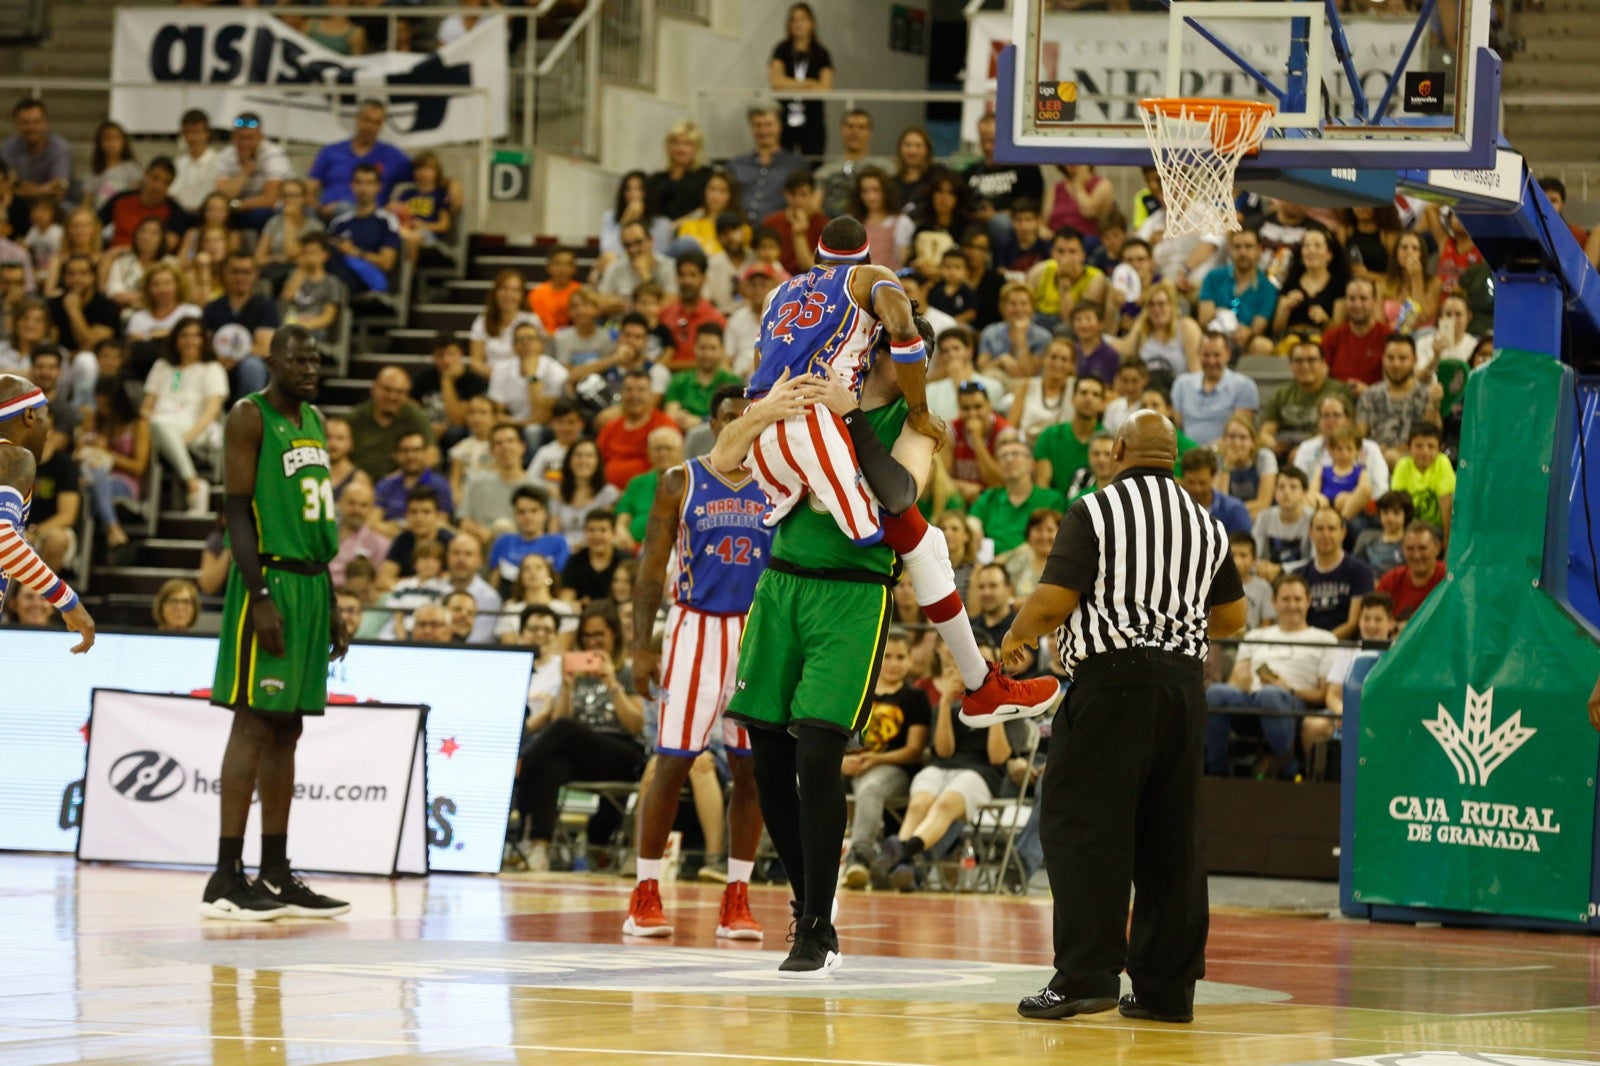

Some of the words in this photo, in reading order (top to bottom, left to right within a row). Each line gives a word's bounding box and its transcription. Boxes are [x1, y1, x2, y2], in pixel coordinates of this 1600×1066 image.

[1039, 100, 1062, 111] LEB
[1039, 111, 1060, 120] ORO
[493, 163, 522, 199] D
[771, 291, 828, 340] 26
[301, 476, 336, 521] 31
[706, 498, 766, 517] HARLEM
[715, 535, 752, 566] 42
[1389, 796, 1450, 822] CAJA
[1460, 800, 1560, 833] RURAL
[1407, 824, 1432, 842] DE
[1436, 825, 1540, 852] GRANADA
